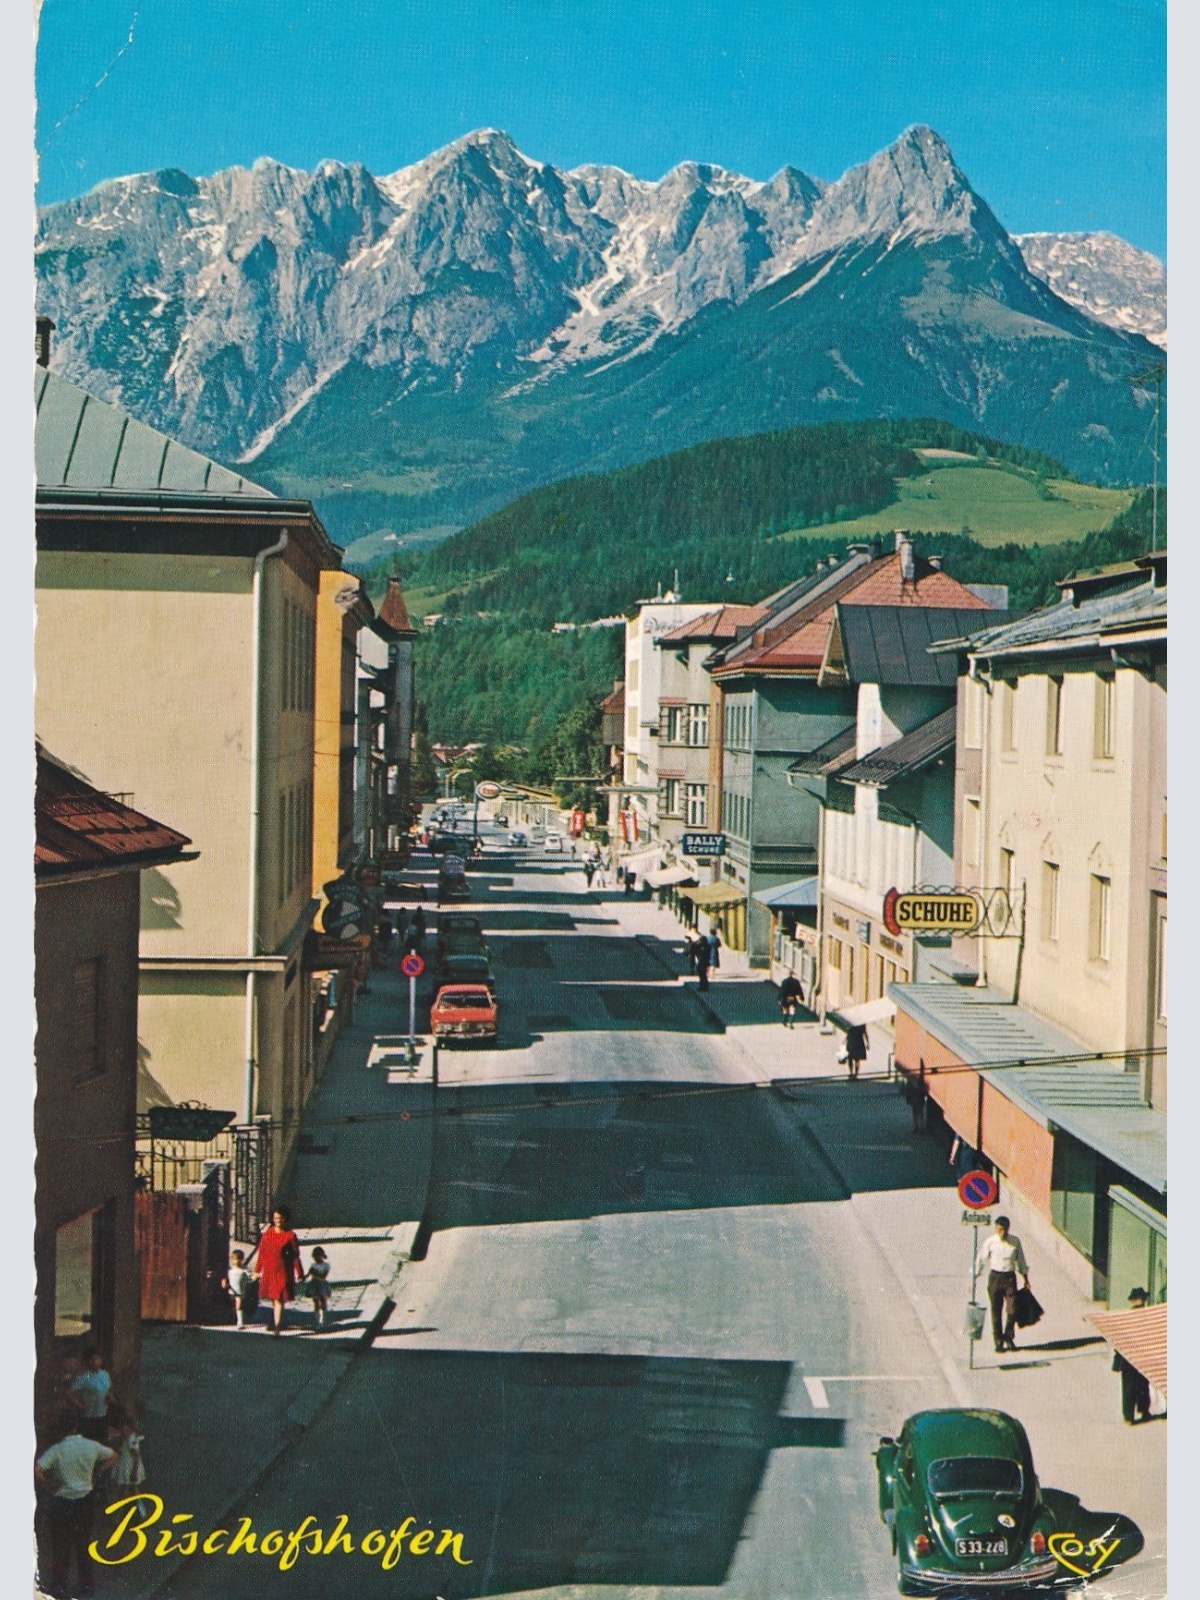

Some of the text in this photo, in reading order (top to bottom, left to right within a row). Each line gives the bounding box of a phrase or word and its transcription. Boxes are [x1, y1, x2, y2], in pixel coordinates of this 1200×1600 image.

[686, 836, 723, 846] BALLY
[899, 901, 973, 922] SCHUHE
[961, 1210, 991, 1226] Anfang
